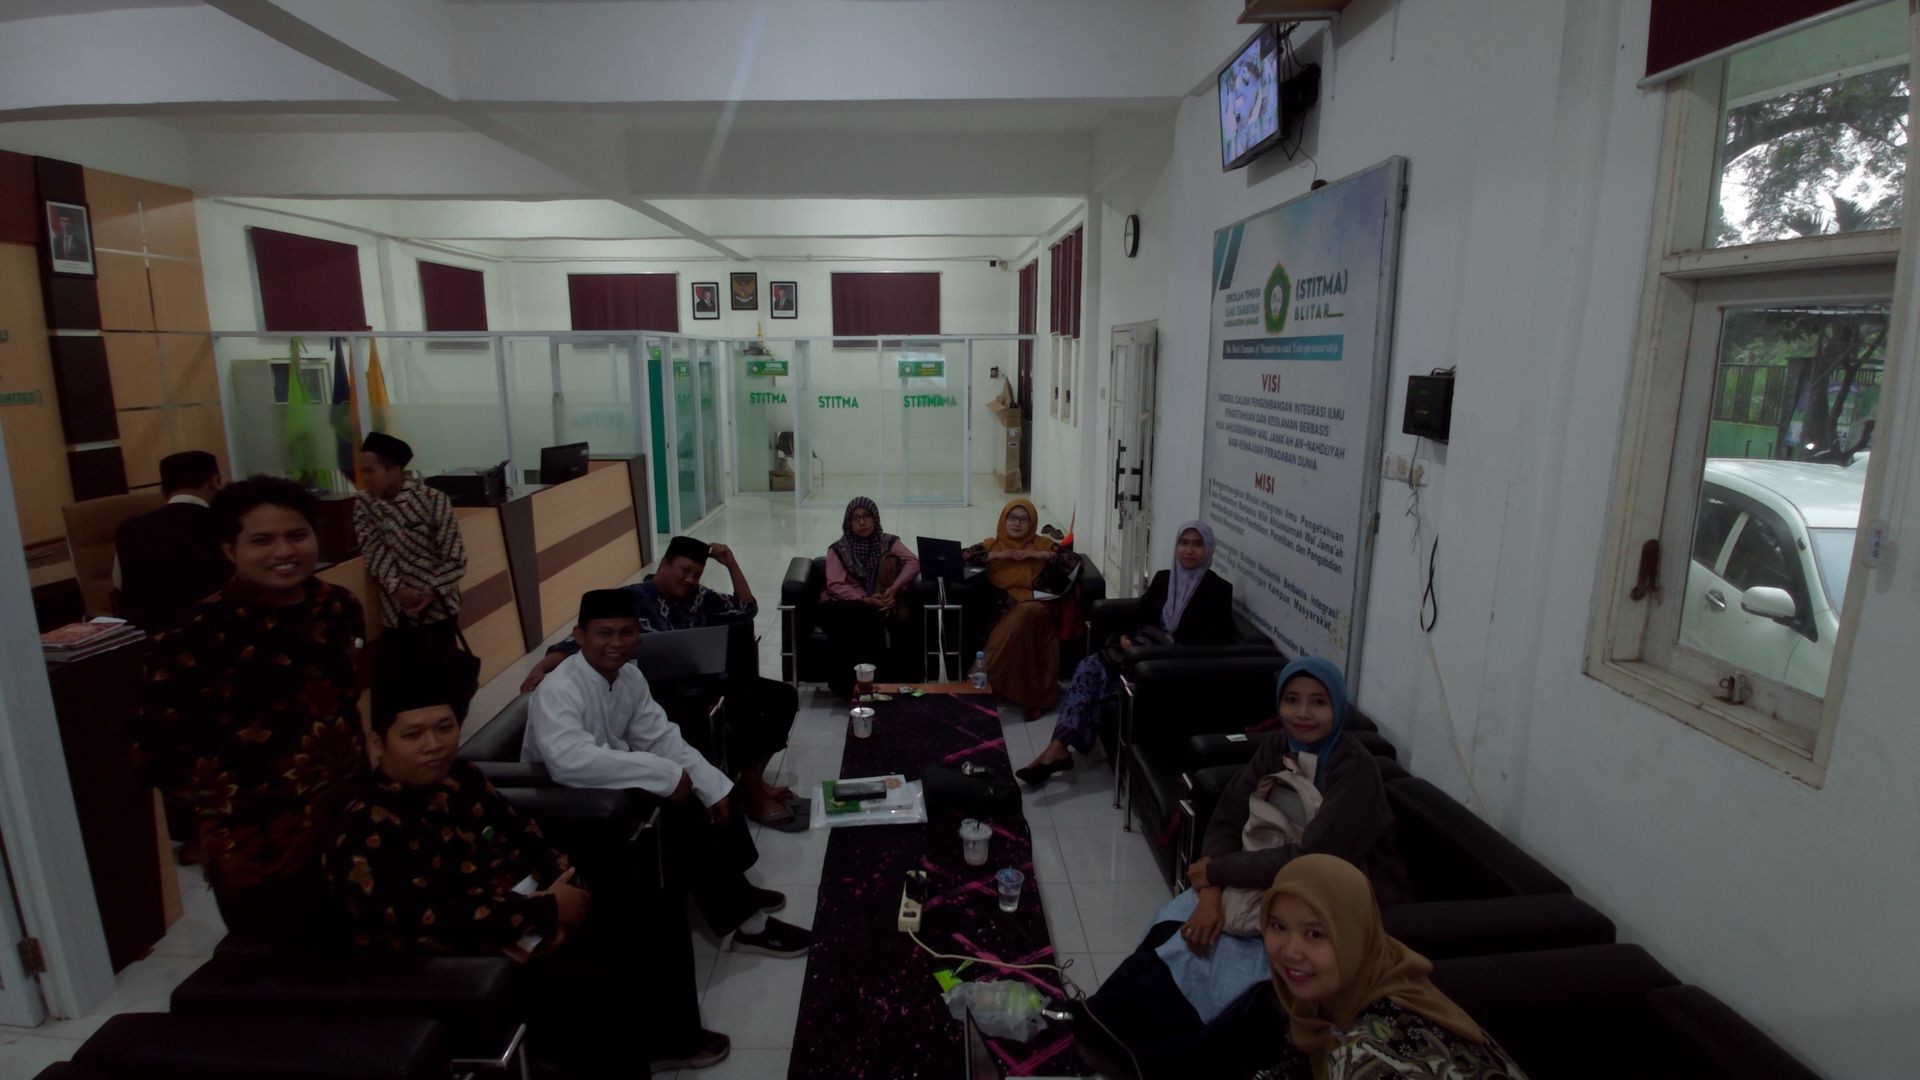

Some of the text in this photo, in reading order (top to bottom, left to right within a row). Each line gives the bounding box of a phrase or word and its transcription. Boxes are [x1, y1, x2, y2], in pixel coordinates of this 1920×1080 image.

[1295, 269, 1348, 301] (STITMA)
[1294, 303, 1330, 321] BLITAR
[1262, 373, 1281, 393] VISI
[750, 392, 787, 405] STITMA
[818, 395, 859, 409] STITMA
[1294, 402, 1326, 418] INTEGRASI
[1327, 407, 1345, 421] ILMU
[1267, 414, 1298, 431] KEISLAMAN
[1299, 420, 1329, 437] BERBASIS
[1297, 455, 1318, 472] DUNIA
[1255, 471, 1275, 496] MISI
[1301, 515, 1344, 543] Pengetahuan
[1305, 531, 1316, 546] Wal
[1307, 547, 1342, 576] Pengabdian
